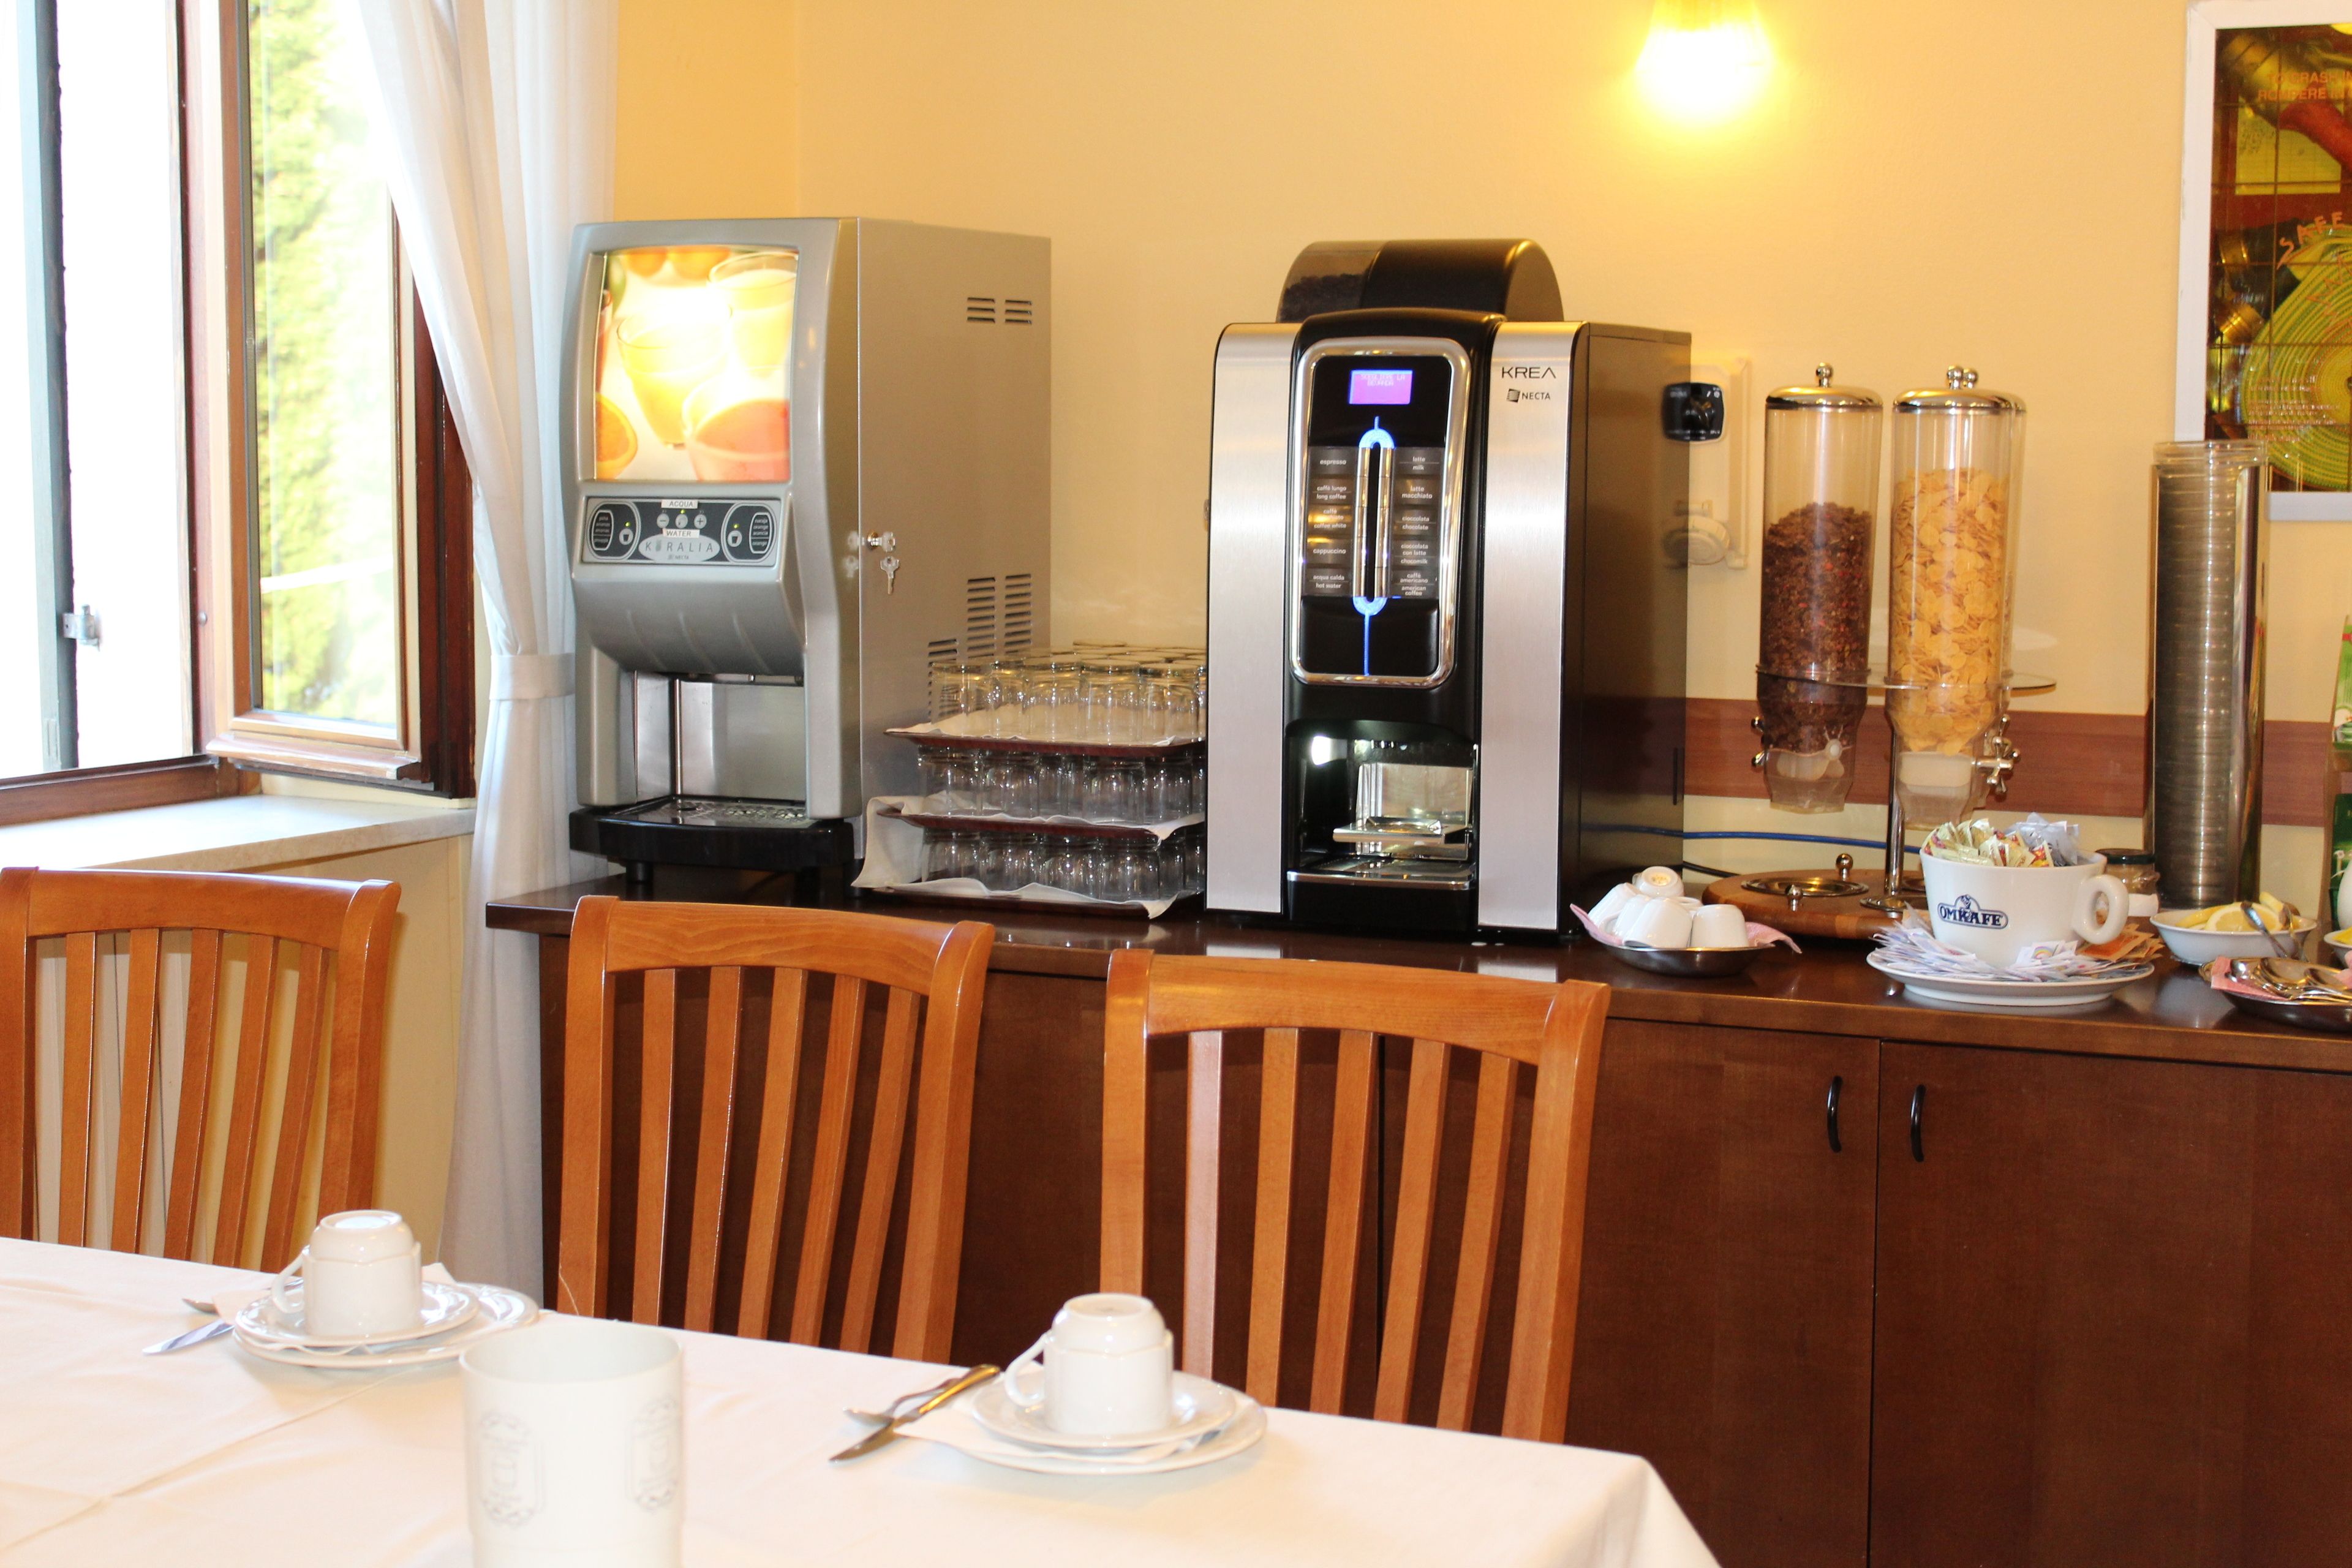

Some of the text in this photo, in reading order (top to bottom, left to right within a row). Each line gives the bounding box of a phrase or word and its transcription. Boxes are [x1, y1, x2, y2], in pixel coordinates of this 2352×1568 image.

[2290, 71, 2336, 84] CRASH
[2258, 88, 2328, 102] ROMPERE
[1501, 366, 1556, 379] KREA
